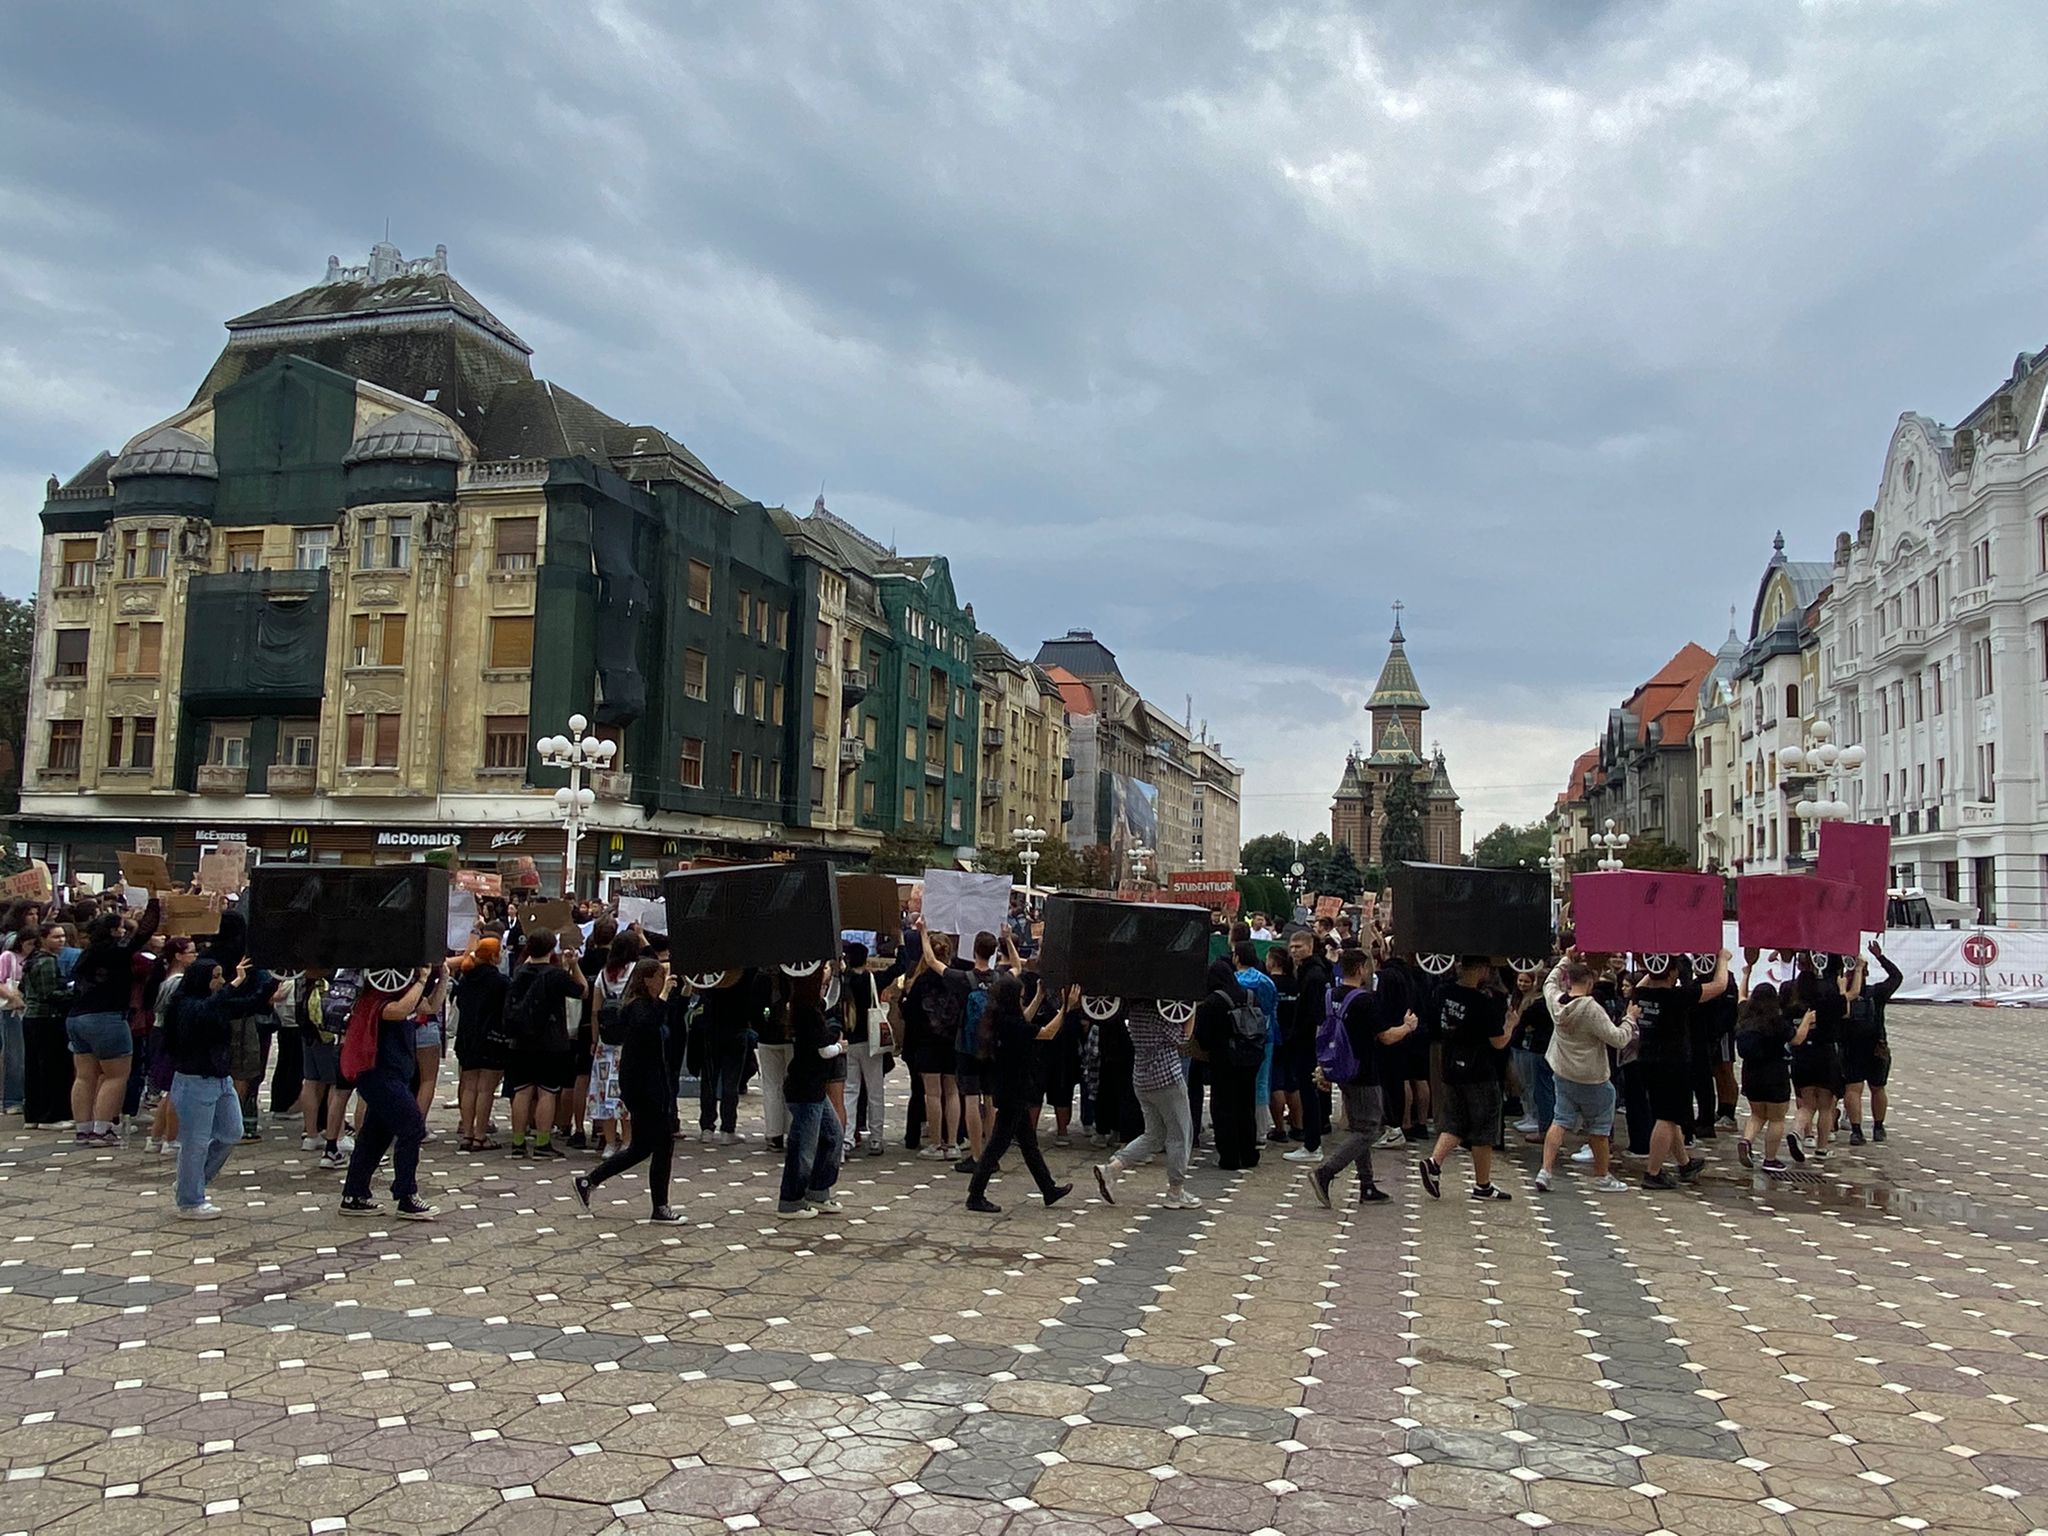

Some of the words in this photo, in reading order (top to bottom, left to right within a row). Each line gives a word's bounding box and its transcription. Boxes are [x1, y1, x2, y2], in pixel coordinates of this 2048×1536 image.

[195, 830, 247, 842] McExpress
[377, 832, 462, 846] McDonald's
[1918, 971, 1991, 986] THEDA
[1998, 972, 2044, 988] MAR
